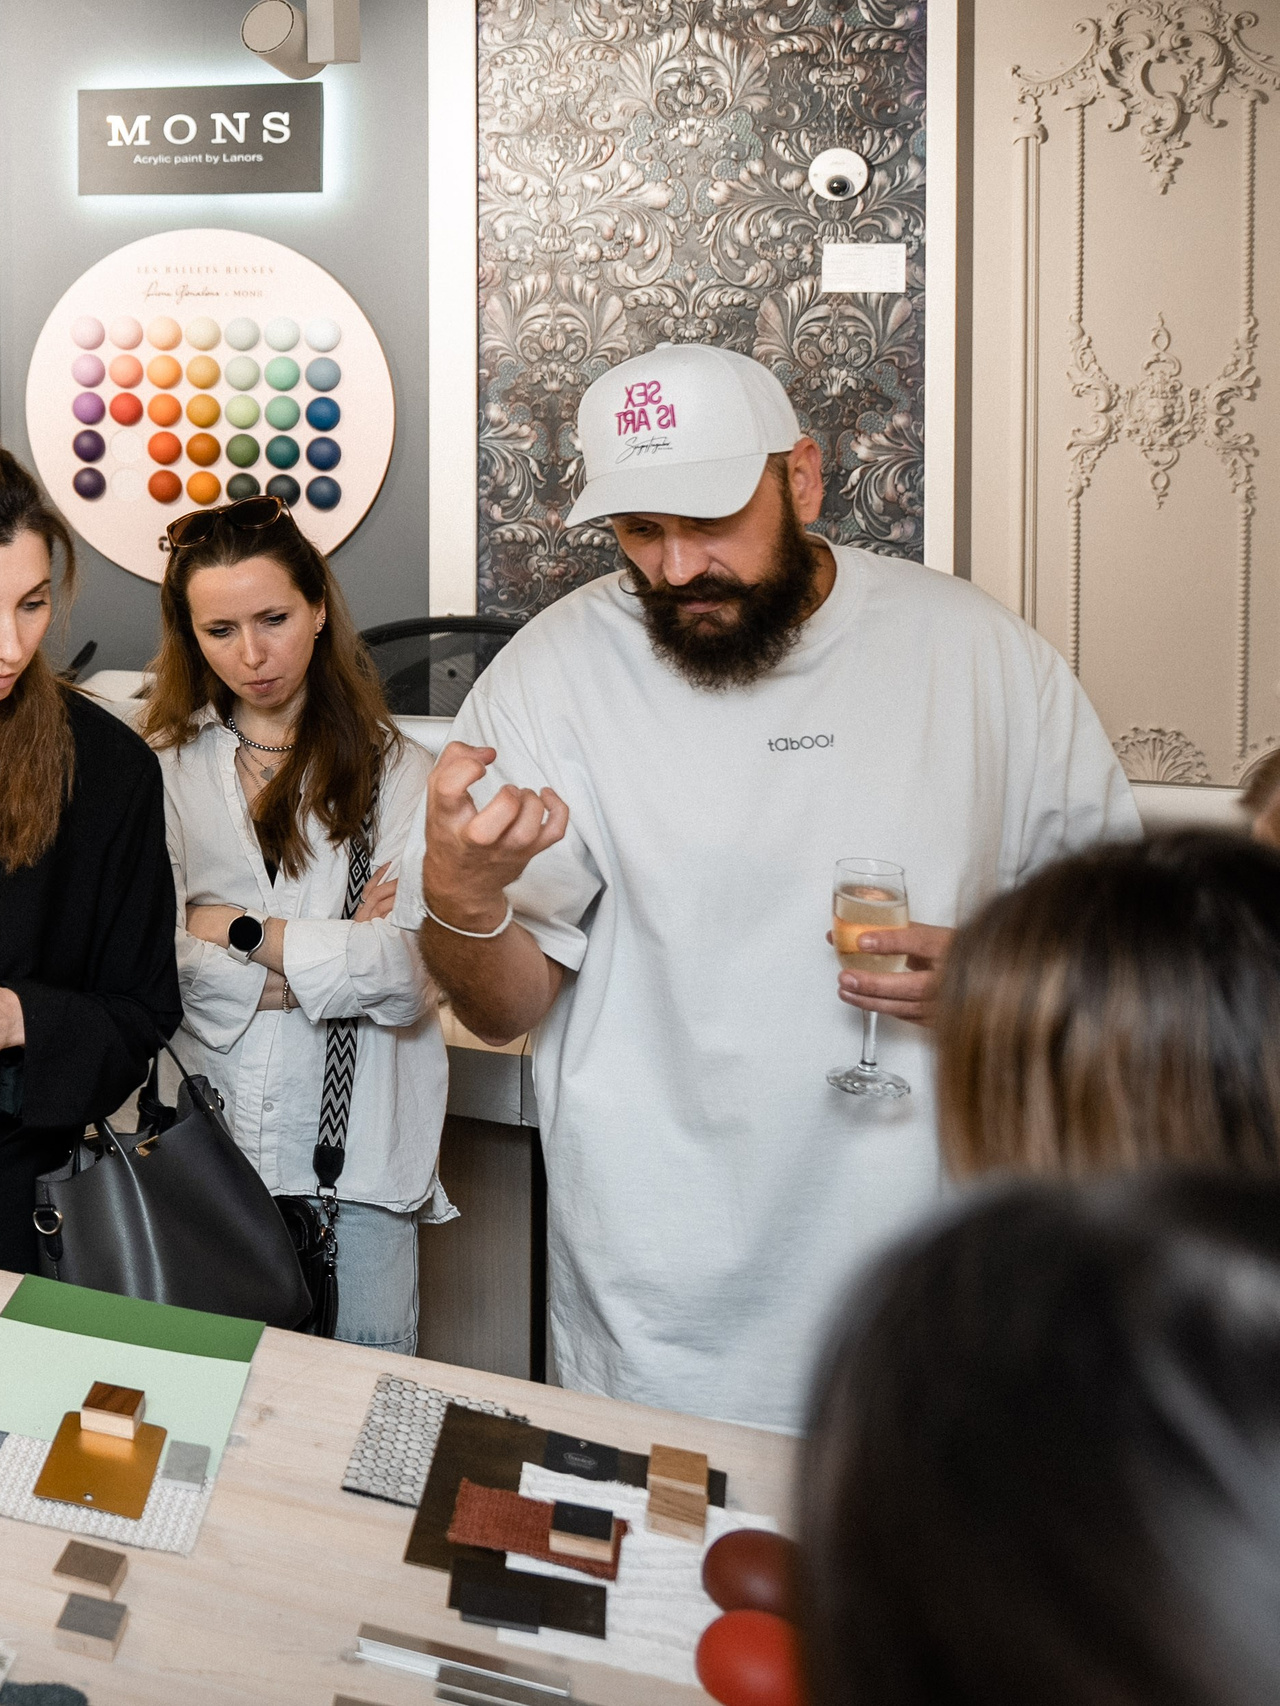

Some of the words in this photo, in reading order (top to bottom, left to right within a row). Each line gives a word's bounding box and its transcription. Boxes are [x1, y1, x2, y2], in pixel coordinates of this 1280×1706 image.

[106, 111, 291, 147] MONS
[133, 154, 171, 166] Acrylic
[174, 154, 202, 165] paint
[205, 153, 220, 165] by
[223, 153, 263, 163] Lanors
